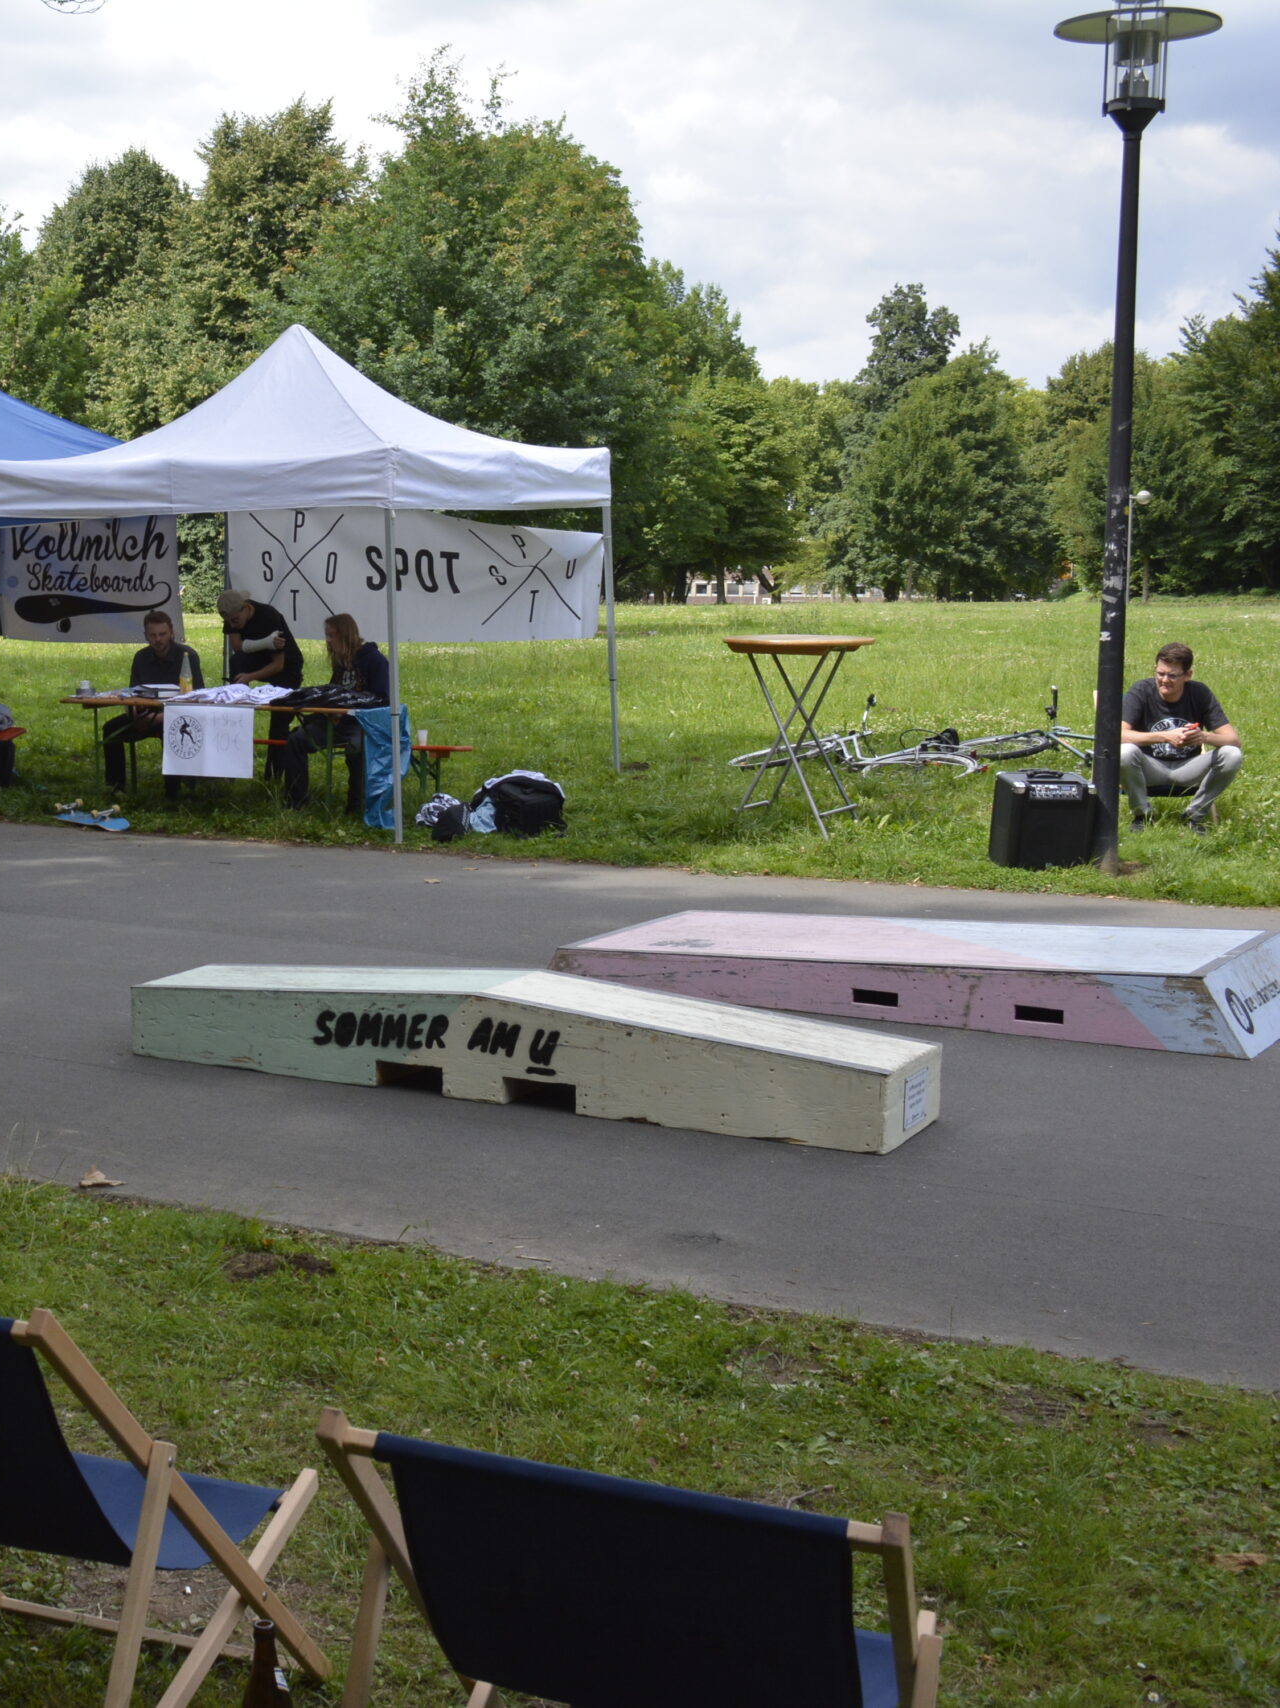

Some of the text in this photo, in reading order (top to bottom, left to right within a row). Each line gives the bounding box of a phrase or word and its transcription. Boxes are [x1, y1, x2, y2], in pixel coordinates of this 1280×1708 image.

[11, 515, 168, 562] Vollmilch
[26, 563, 155, 593] Skateboards
[365, 545, 460, 594] SPOT
[313, 1010, 560, 1076] SOMMER AM U
